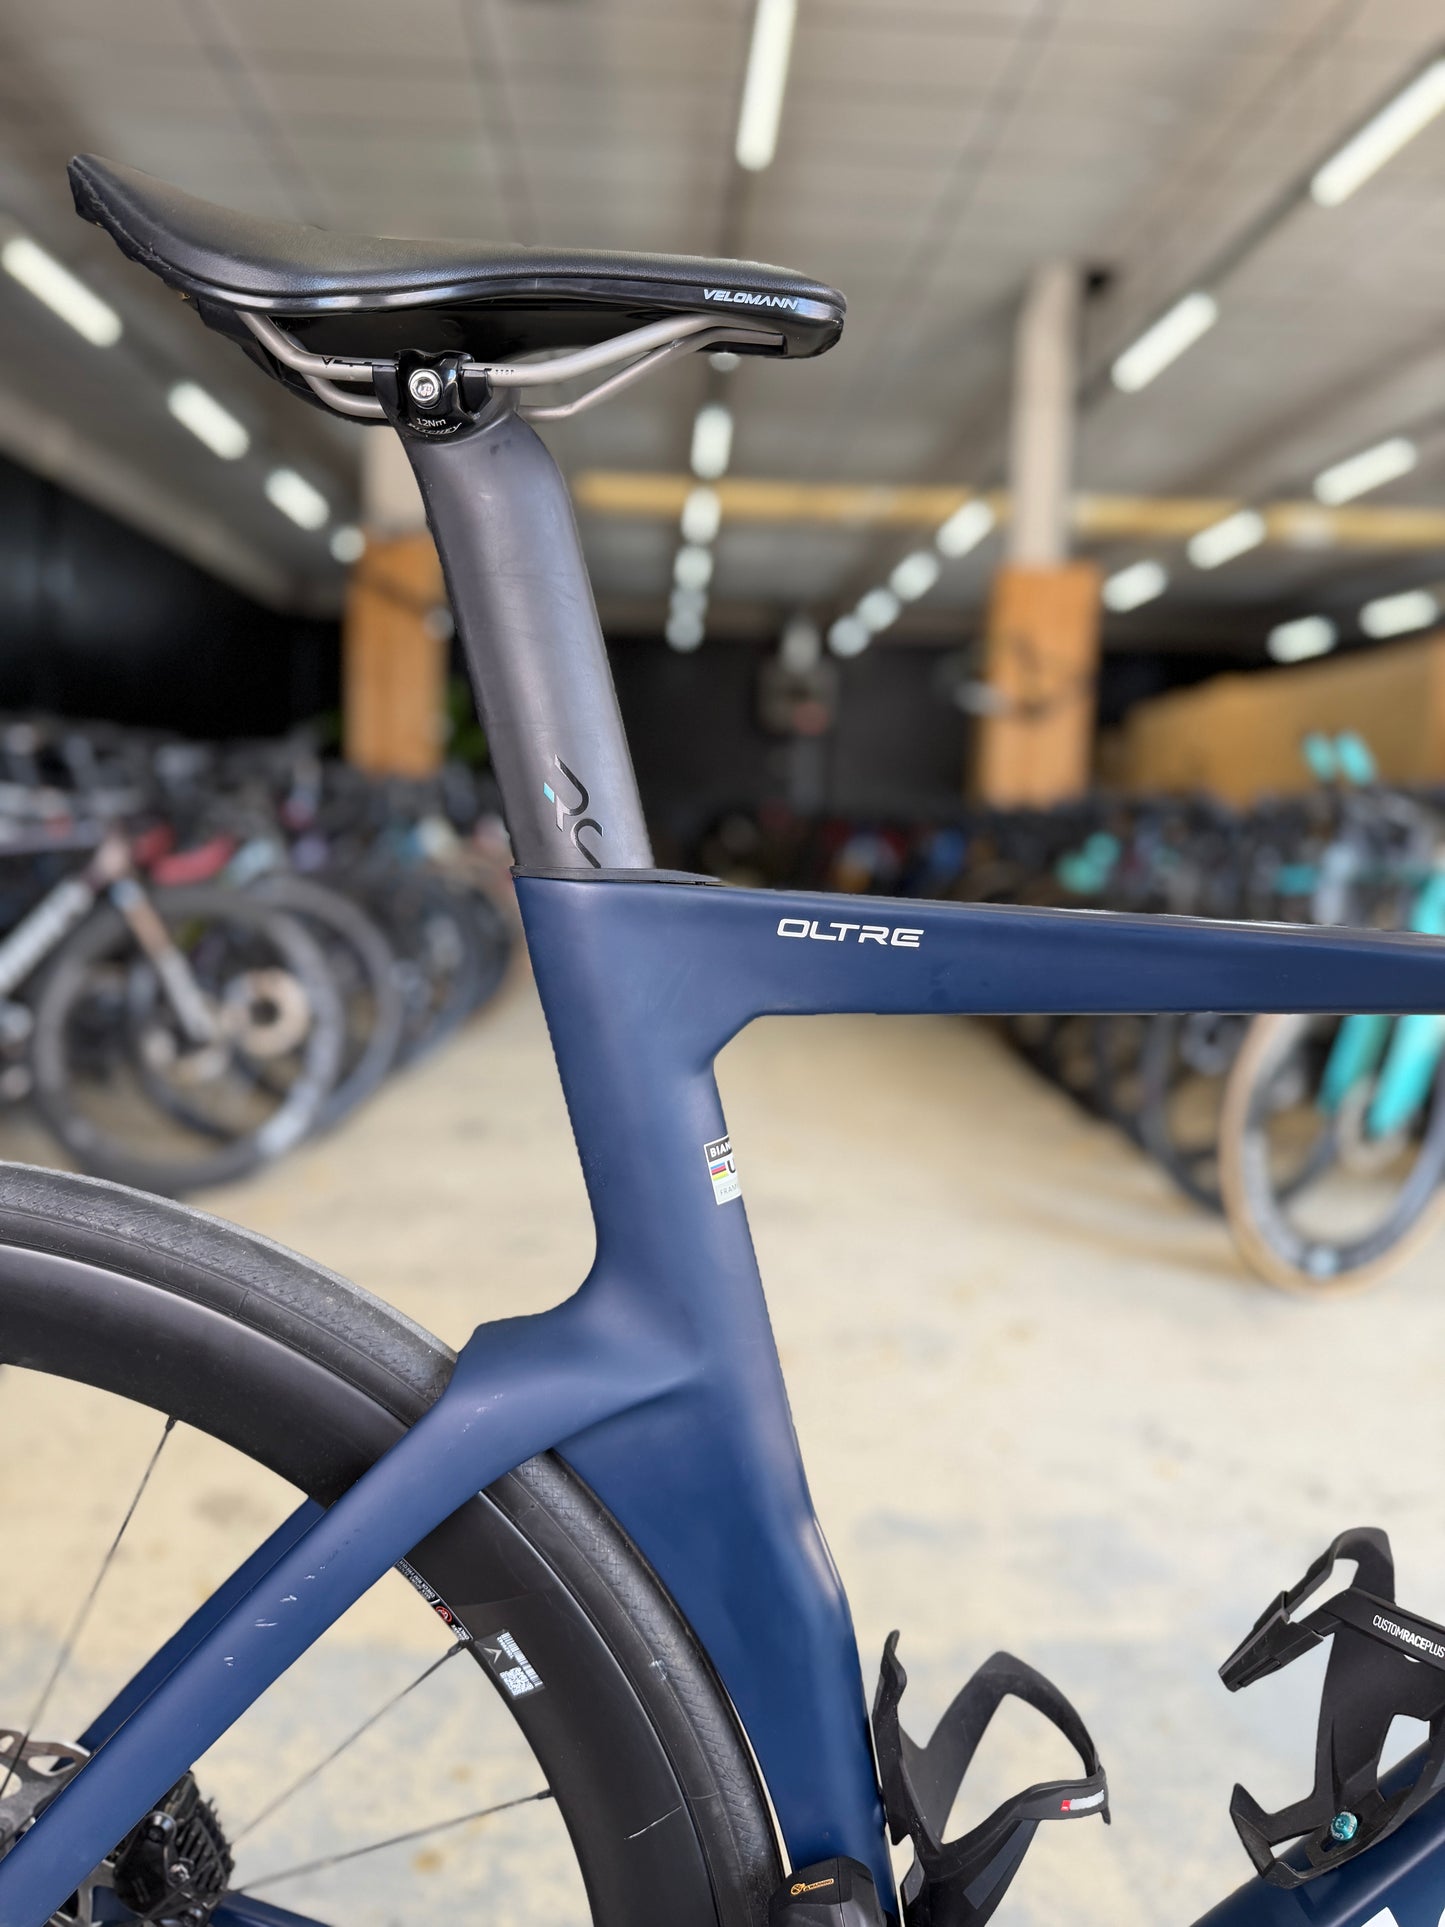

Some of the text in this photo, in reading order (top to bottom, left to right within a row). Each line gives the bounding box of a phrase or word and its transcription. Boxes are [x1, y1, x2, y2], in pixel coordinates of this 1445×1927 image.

[703, 288, 799, 311] VELOMANN
[416, 417, 446, 427] 12Nm
[776, 917, 925, 948] OLTRE
[1372, 1614, 1445, 1658] CUSTOMRACEPLUS
